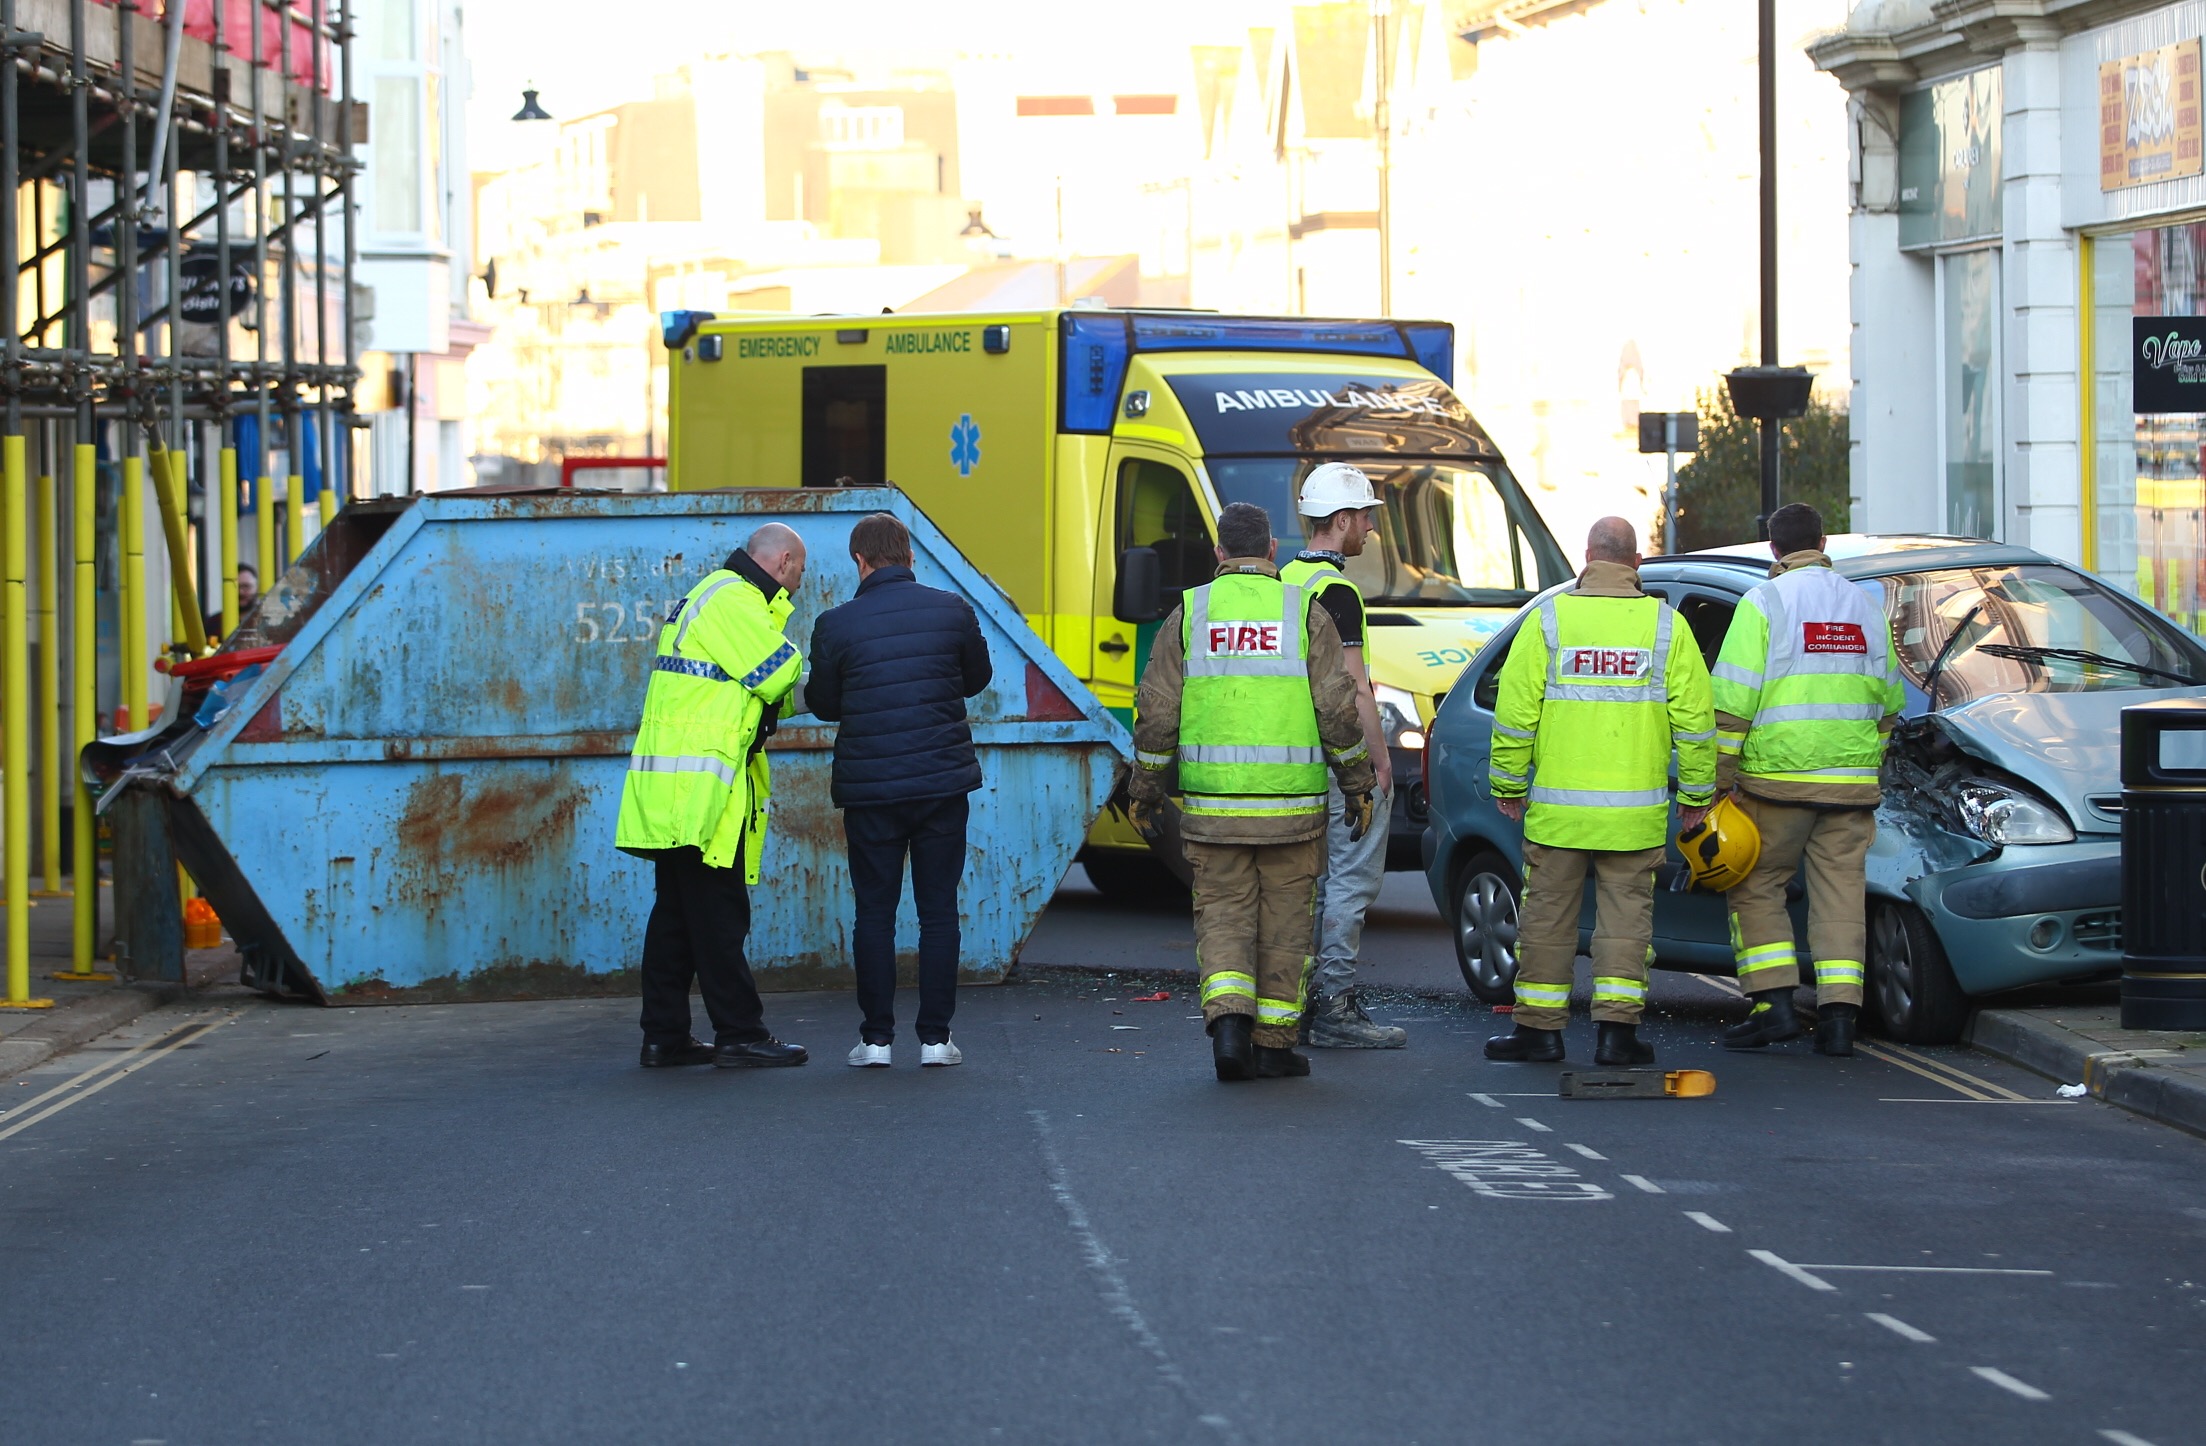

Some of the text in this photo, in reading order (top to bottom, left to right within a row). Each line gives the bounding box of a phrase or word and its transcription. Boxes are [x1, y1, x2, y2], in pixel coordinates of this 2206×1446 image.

[739, 332, 970, 358] EMERGENCY AMBULANCE
[2142, 331, 2202, 369] Vape
[1215, 389, 1451, 418] AMBULANCE
[1210, 626, 1277, 652] FIRE
[1826, 624, 1844, 632] FIRE
[1808, 643, 1865, 651] COMMANDER
[1574, 649, 1638, 675] FIRE
